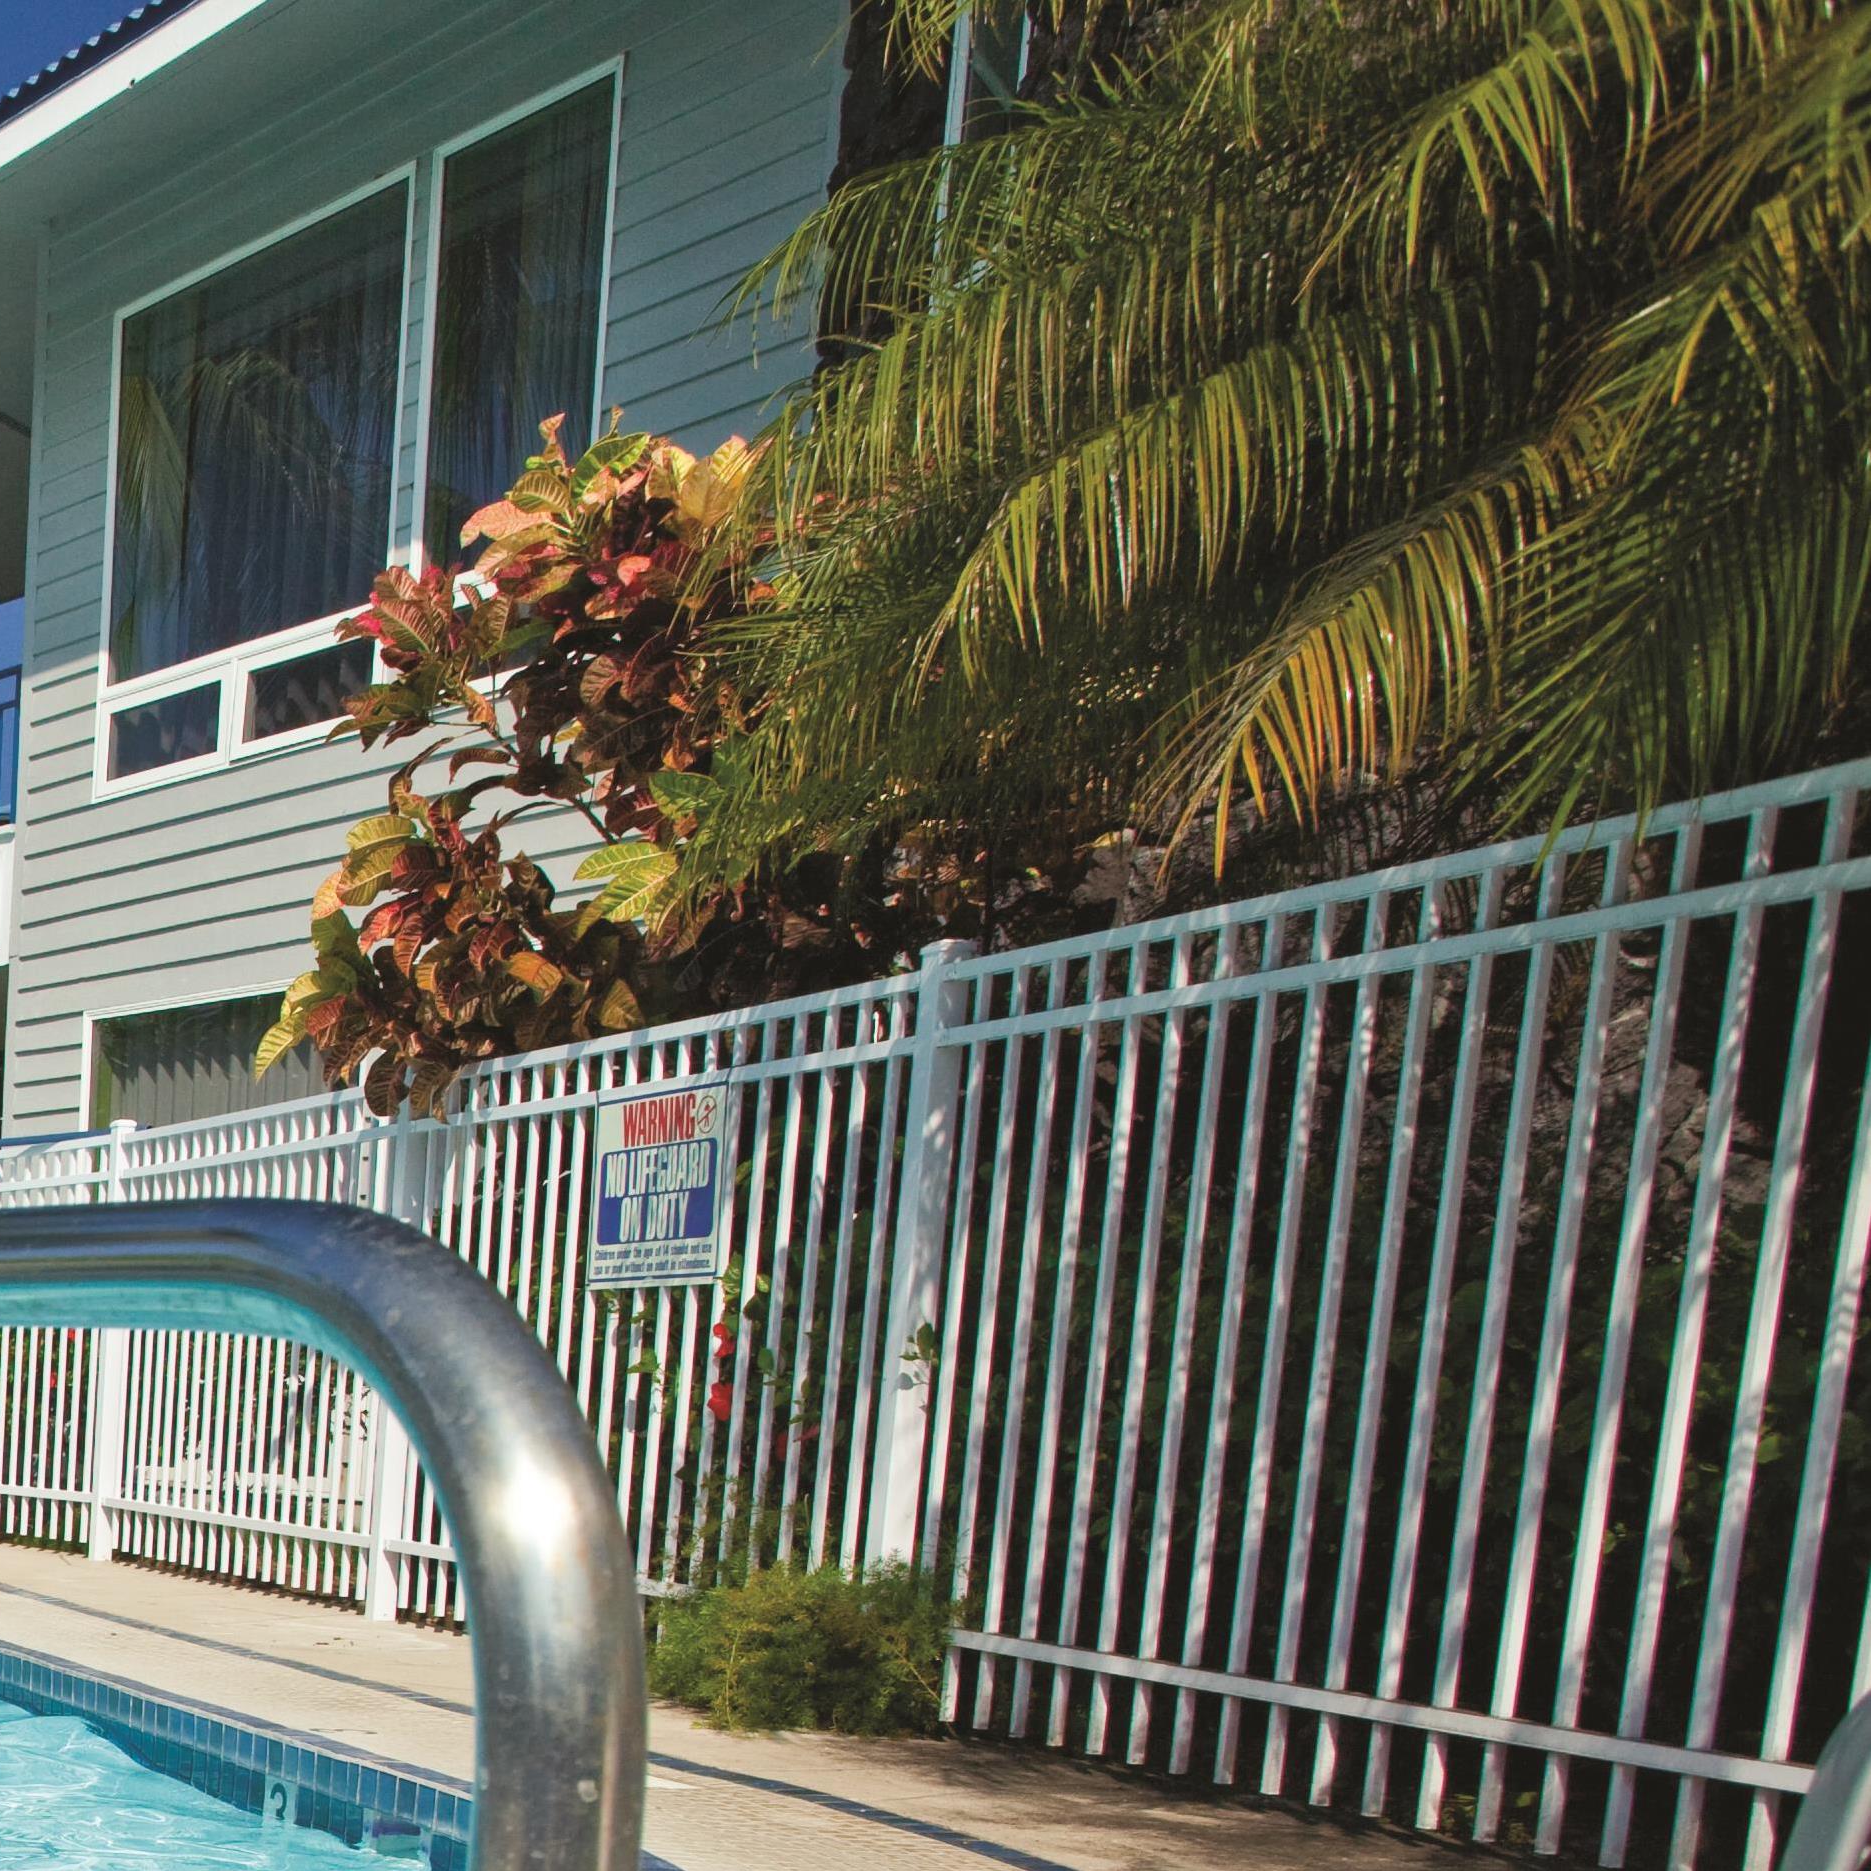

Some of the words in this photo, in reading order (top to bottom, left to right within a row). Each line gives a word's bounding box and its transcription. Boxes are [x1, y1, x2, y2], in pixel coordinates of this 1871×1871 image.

[623, 1093, 697, 1148] WARNING
[605, 1152, 628, 1198] NO
[628, 1141, 710, 1196] LIFEGUARD
[619, 1196, 643, 1243] ON
[645, 1191, 690, 1241] DUTY
